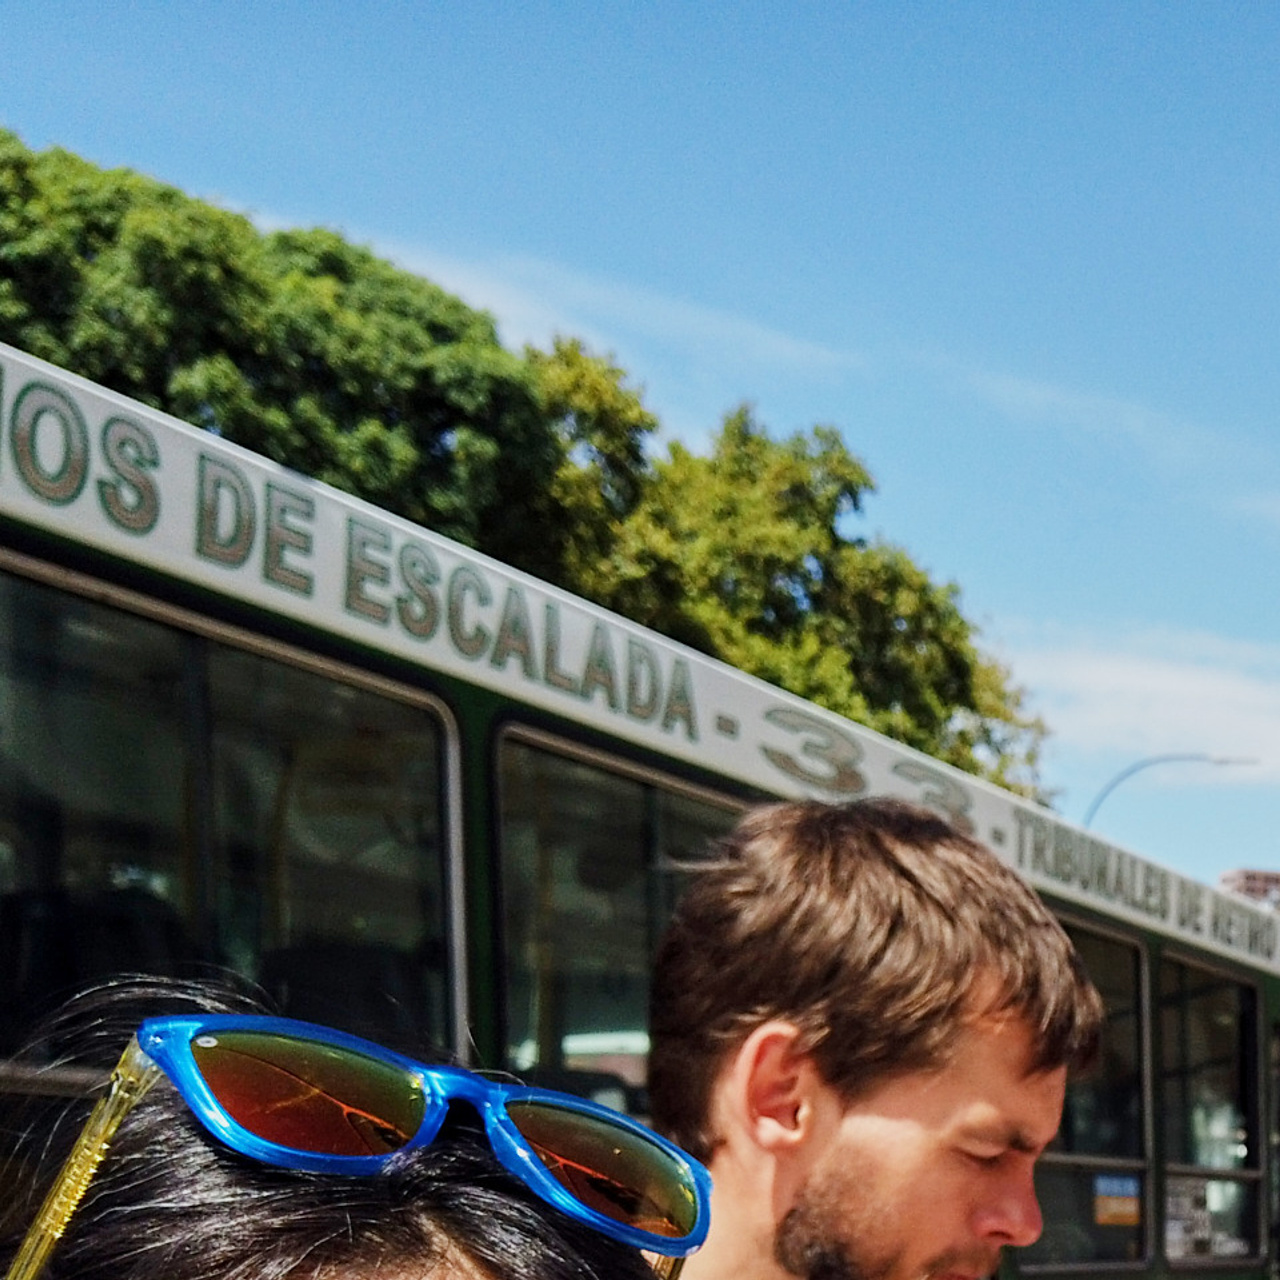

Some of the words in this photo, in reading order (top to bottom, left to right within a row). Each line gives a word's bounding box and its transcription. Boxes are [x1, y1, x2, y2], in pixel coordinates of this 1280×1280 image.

[0, 364, 161, 538] OS
[195, 451, 317, 598] DE
[344, 513, 699, 742] ESCALADA
